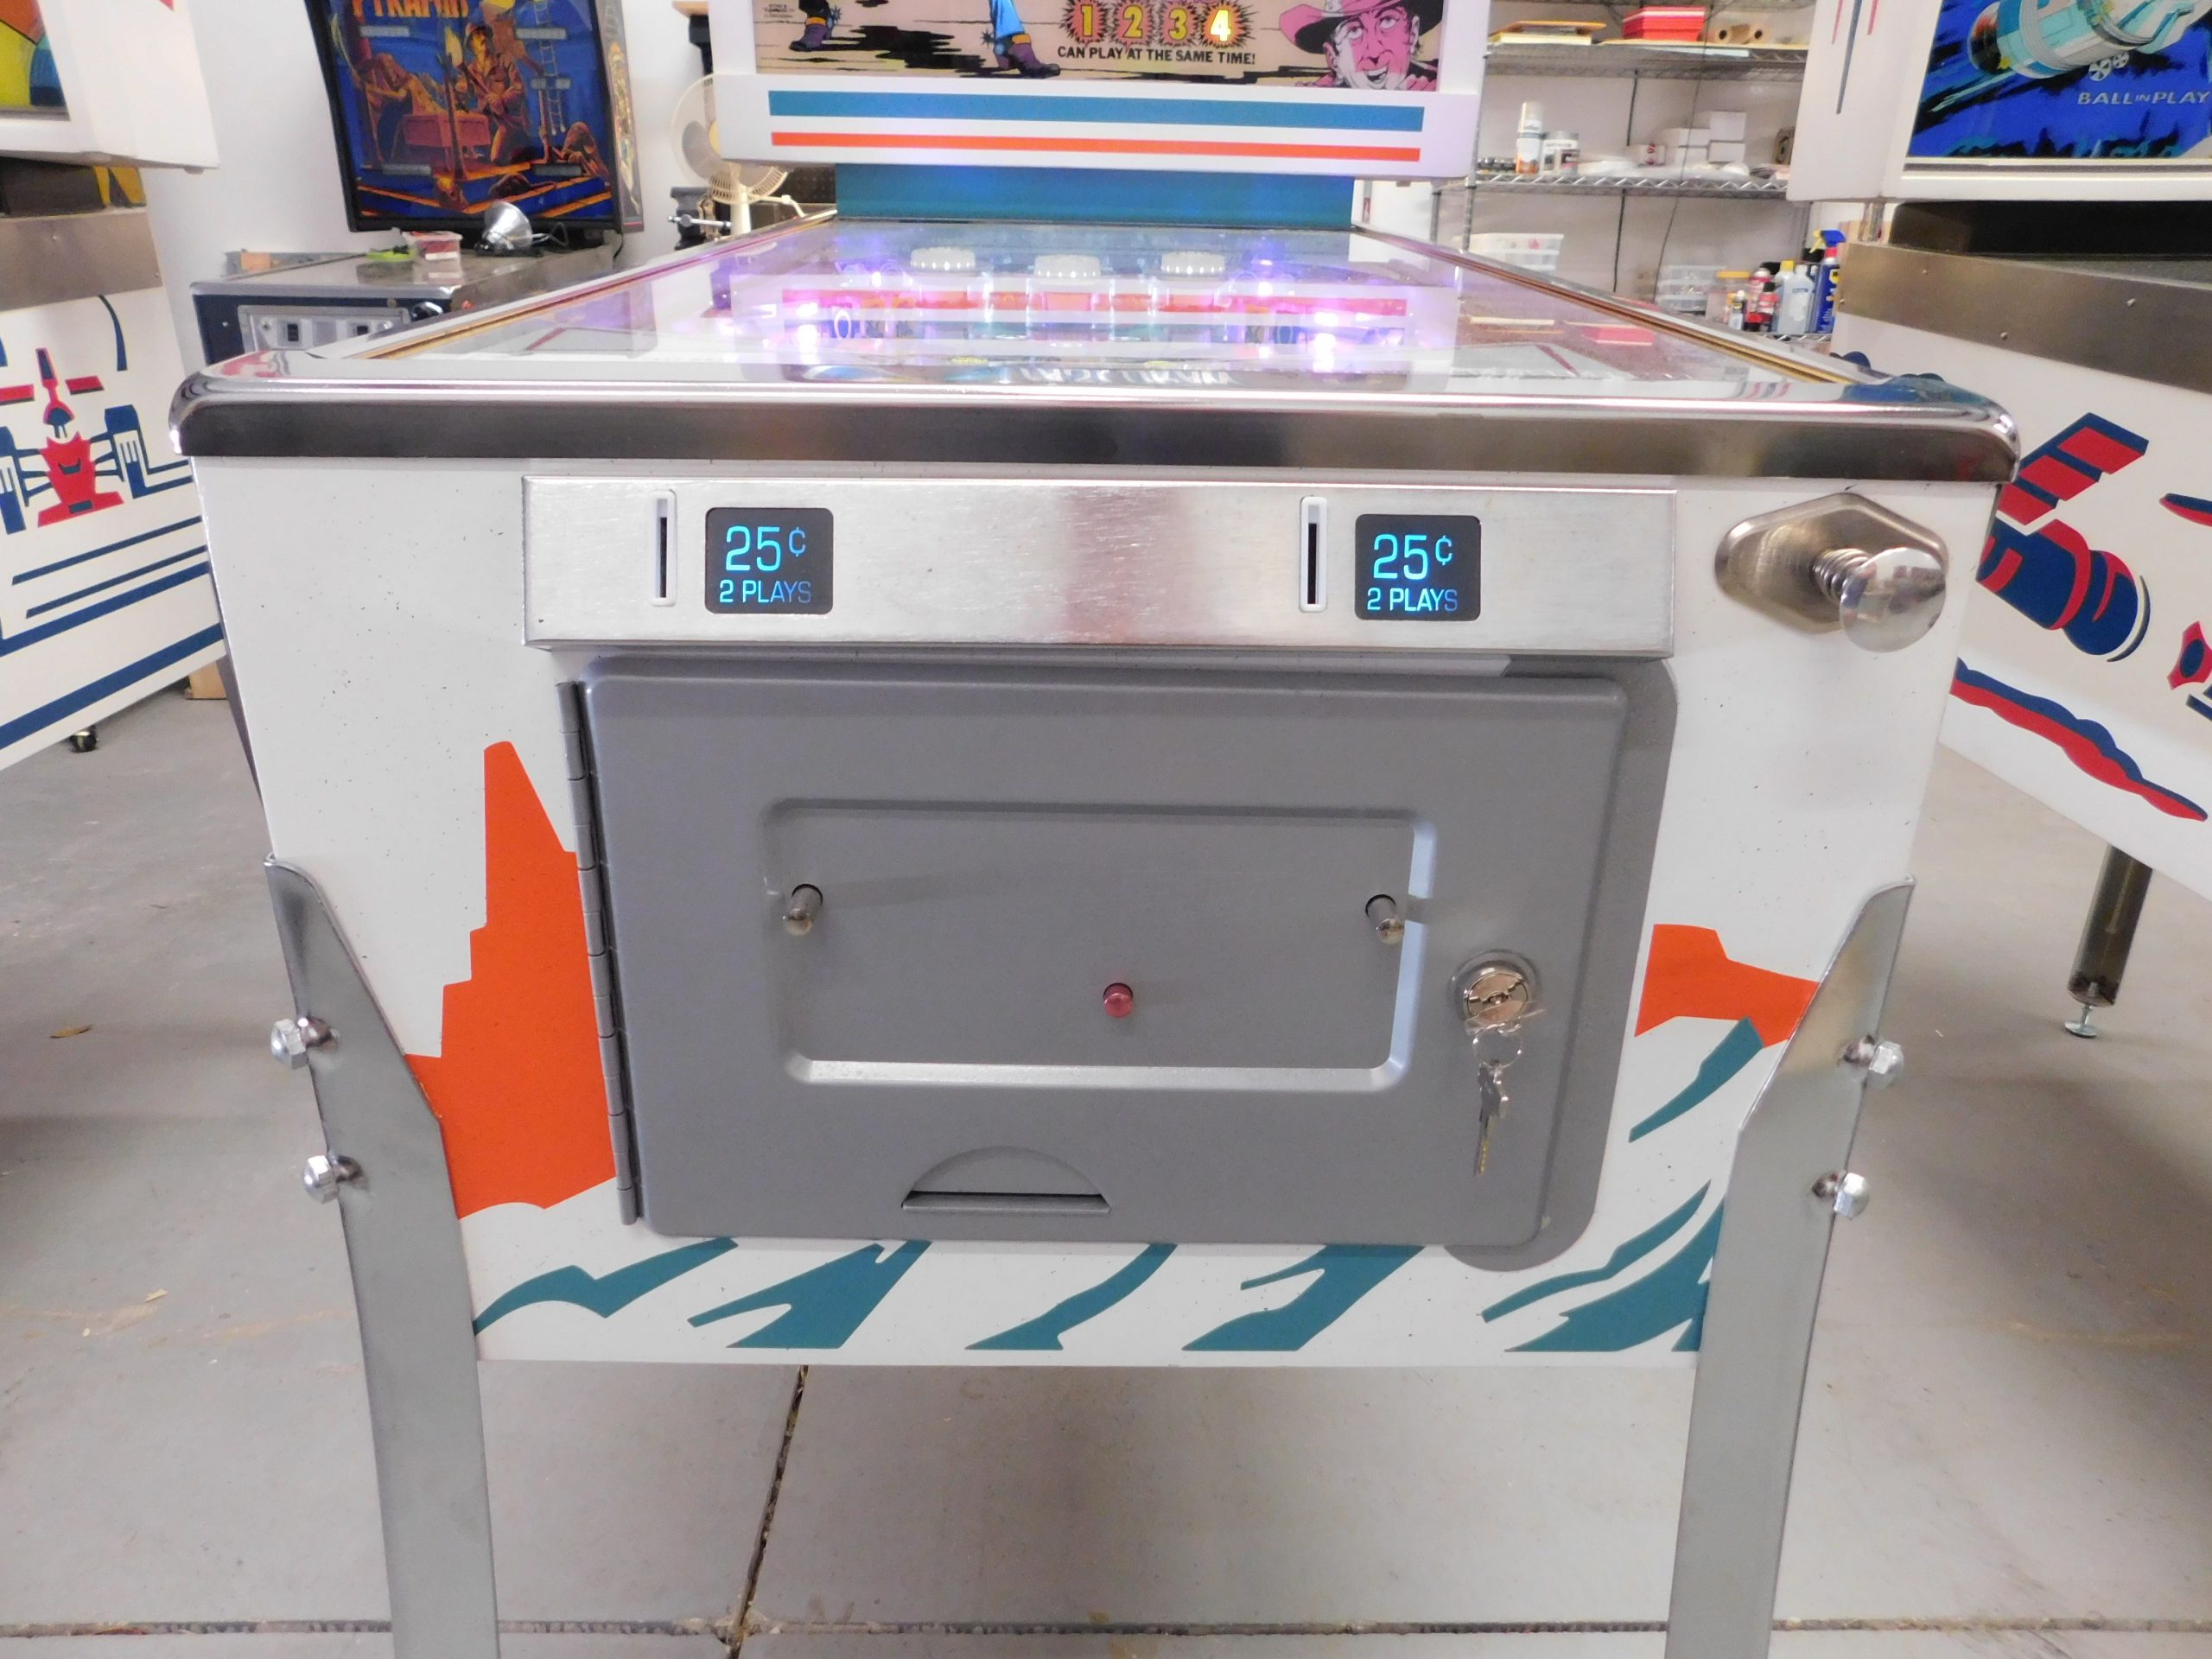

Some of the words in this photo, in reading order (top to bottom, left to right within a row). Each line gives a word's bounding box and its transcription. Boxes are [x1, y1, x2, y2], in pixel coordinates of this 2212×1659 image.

[1081, 4, 1093, 36] 1
[1123, 4, 1143, 38] 2
[1168, 8, 1188, 41] 3
[1210, 9, 1231, 41] 4
[1057, 46, 1085, 59] CAN
[1089, 48, 1122, 60] PLAY
[1127, 48, 1143, 60] AT
[1147, 48, 1173, 61] THE
[1175, 50, 1213, 63] SAME
[1217, 51, 1255, 65] TIME!
[2077, 92, 2133, 105] BALL
[2152, 92, 2210, 105] PLAY
[719, 580, 734, 603] 2
[742, 580, 811, 604] PLAYS
[1367, 588, 1381, 610] 2
[1389, 588, 1458, 612] PLAYS
